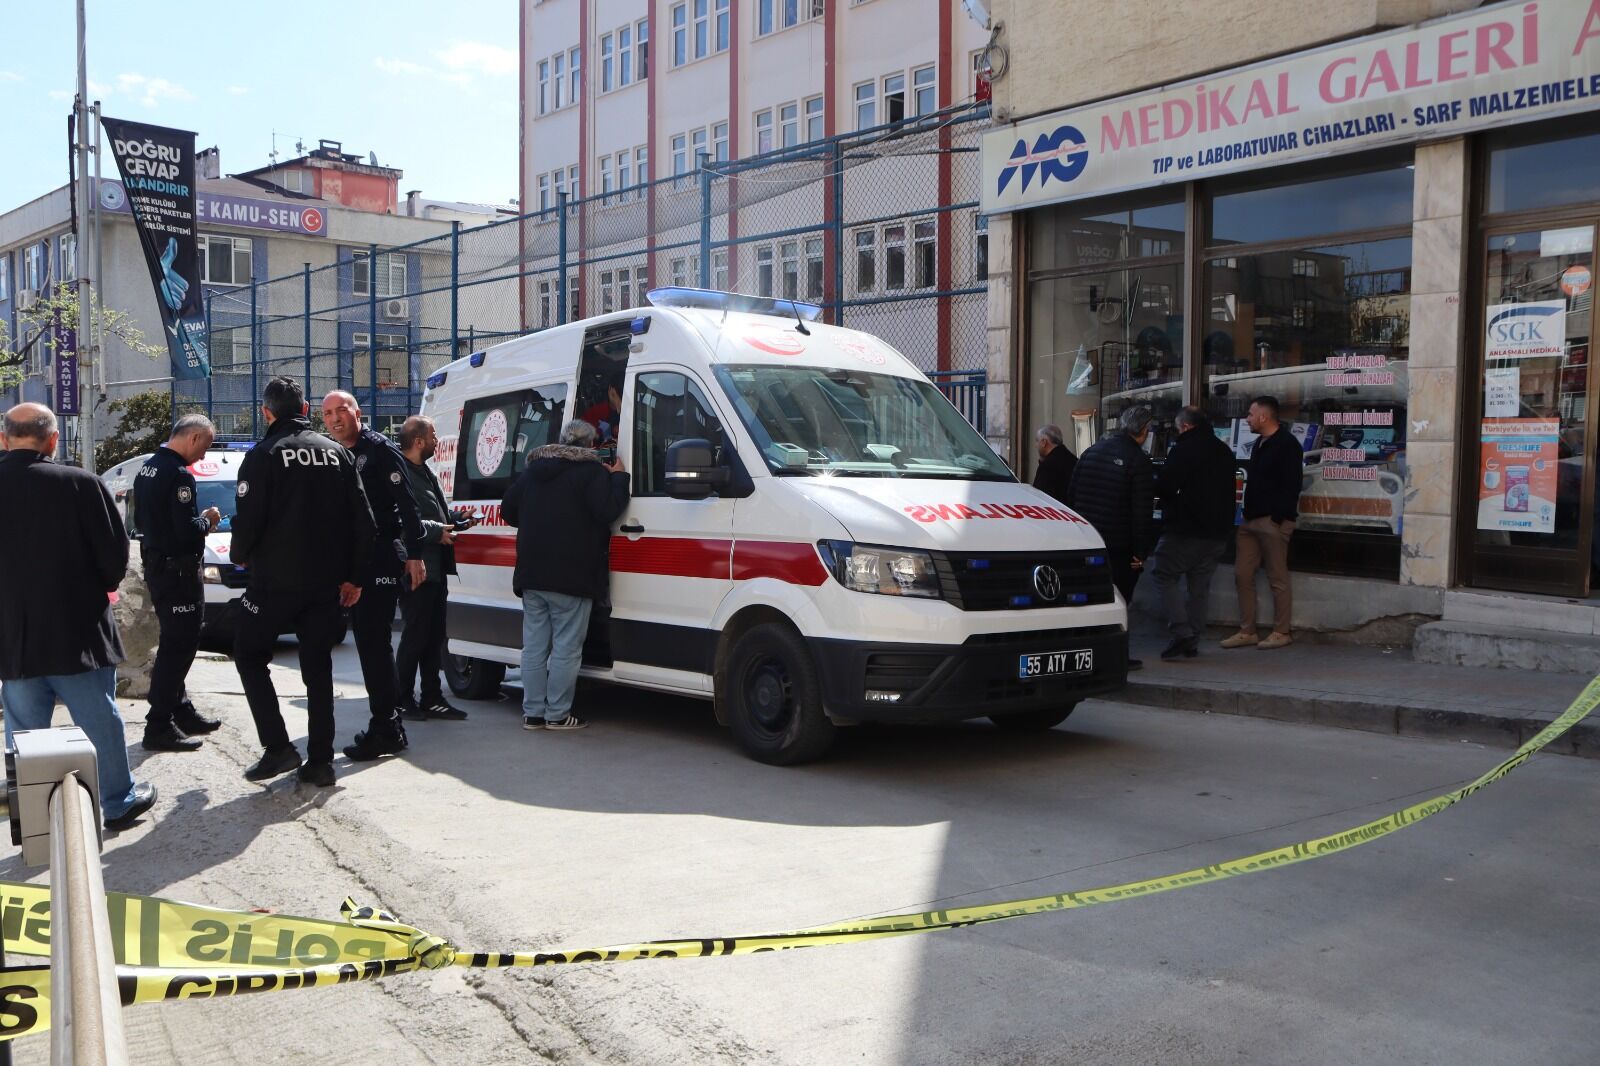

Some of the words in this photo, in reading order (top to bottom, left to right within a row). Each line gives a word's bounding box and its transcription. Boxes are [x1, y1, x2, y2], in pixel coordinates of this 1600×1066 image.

[1100, 72, 1300, 154] MEDİKAL
[1318, 3, 1539, 104] GALERİ
[1153, 155, 1173, 174] TIP
[1178, 156, 1193, 170] ve
[1198, 131, 1298, 167] LABORATUVAR
[1413, 101, 1463, 127] SARF
[114, 139, 180, 163] DOĞRU
[125, 158, 180, 181] CEVAP
[160, 207, 191, 219] PAKETLER
[211, 202, 299, 227] KAMU-SEN
[1496, 320, 1544, 343] SGK
[1027, 656, 1041, 675] 55
[1047, 653, 1067, 673] ATY
[1074, 651, 1091, 670] 175
